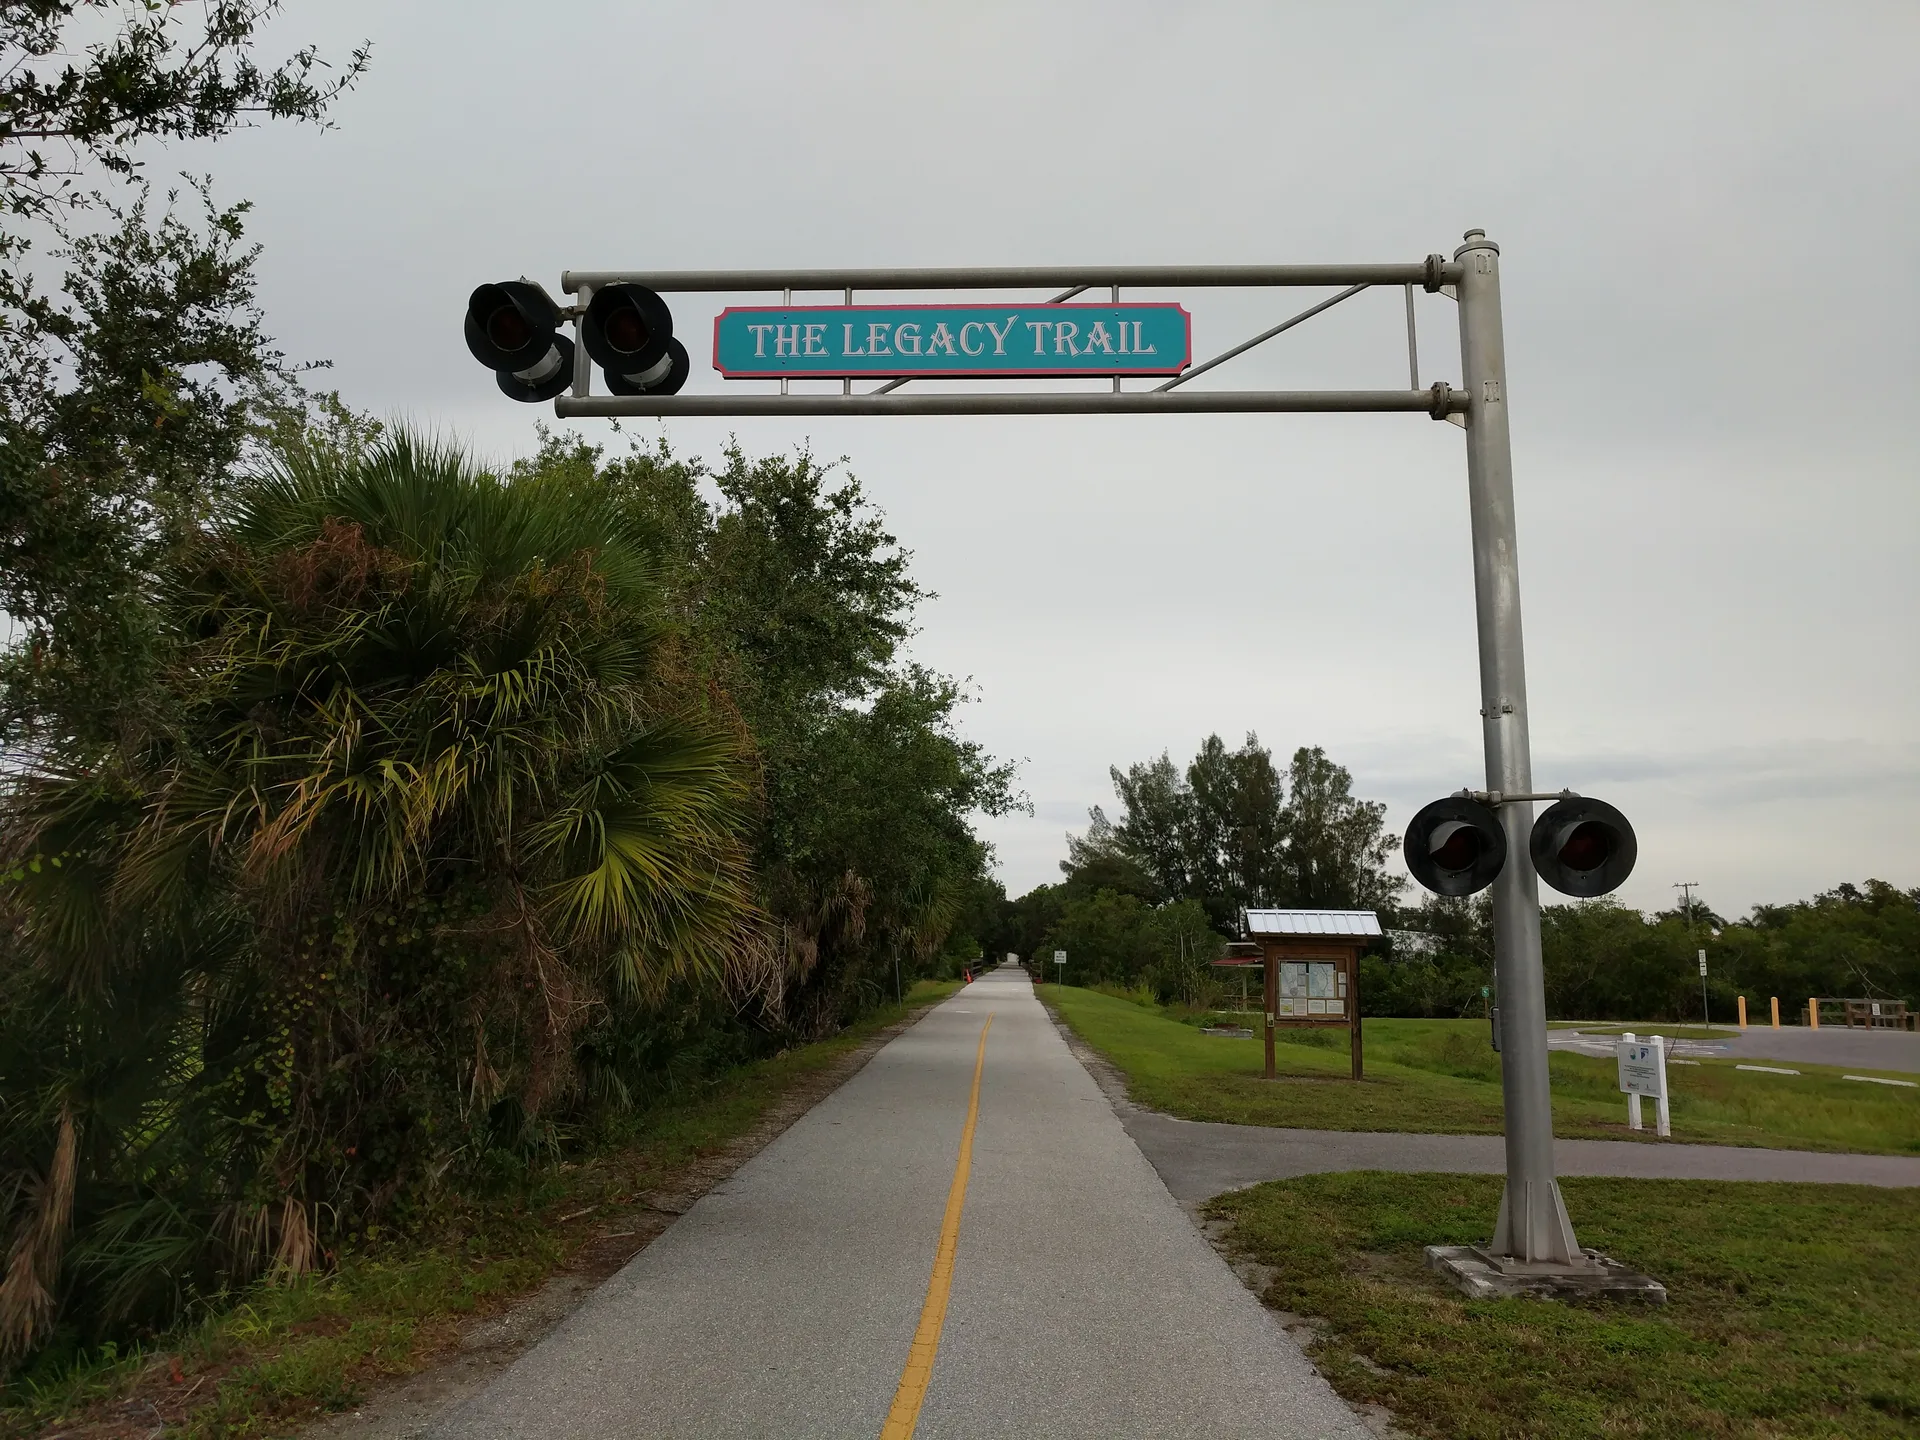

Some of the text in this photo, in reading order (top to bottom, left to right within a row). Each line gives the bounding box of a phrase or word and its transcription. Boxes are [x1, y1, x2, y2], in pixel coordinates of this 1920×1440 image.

[747, 314, 1157, 358] THE LEGACY TRAIL
